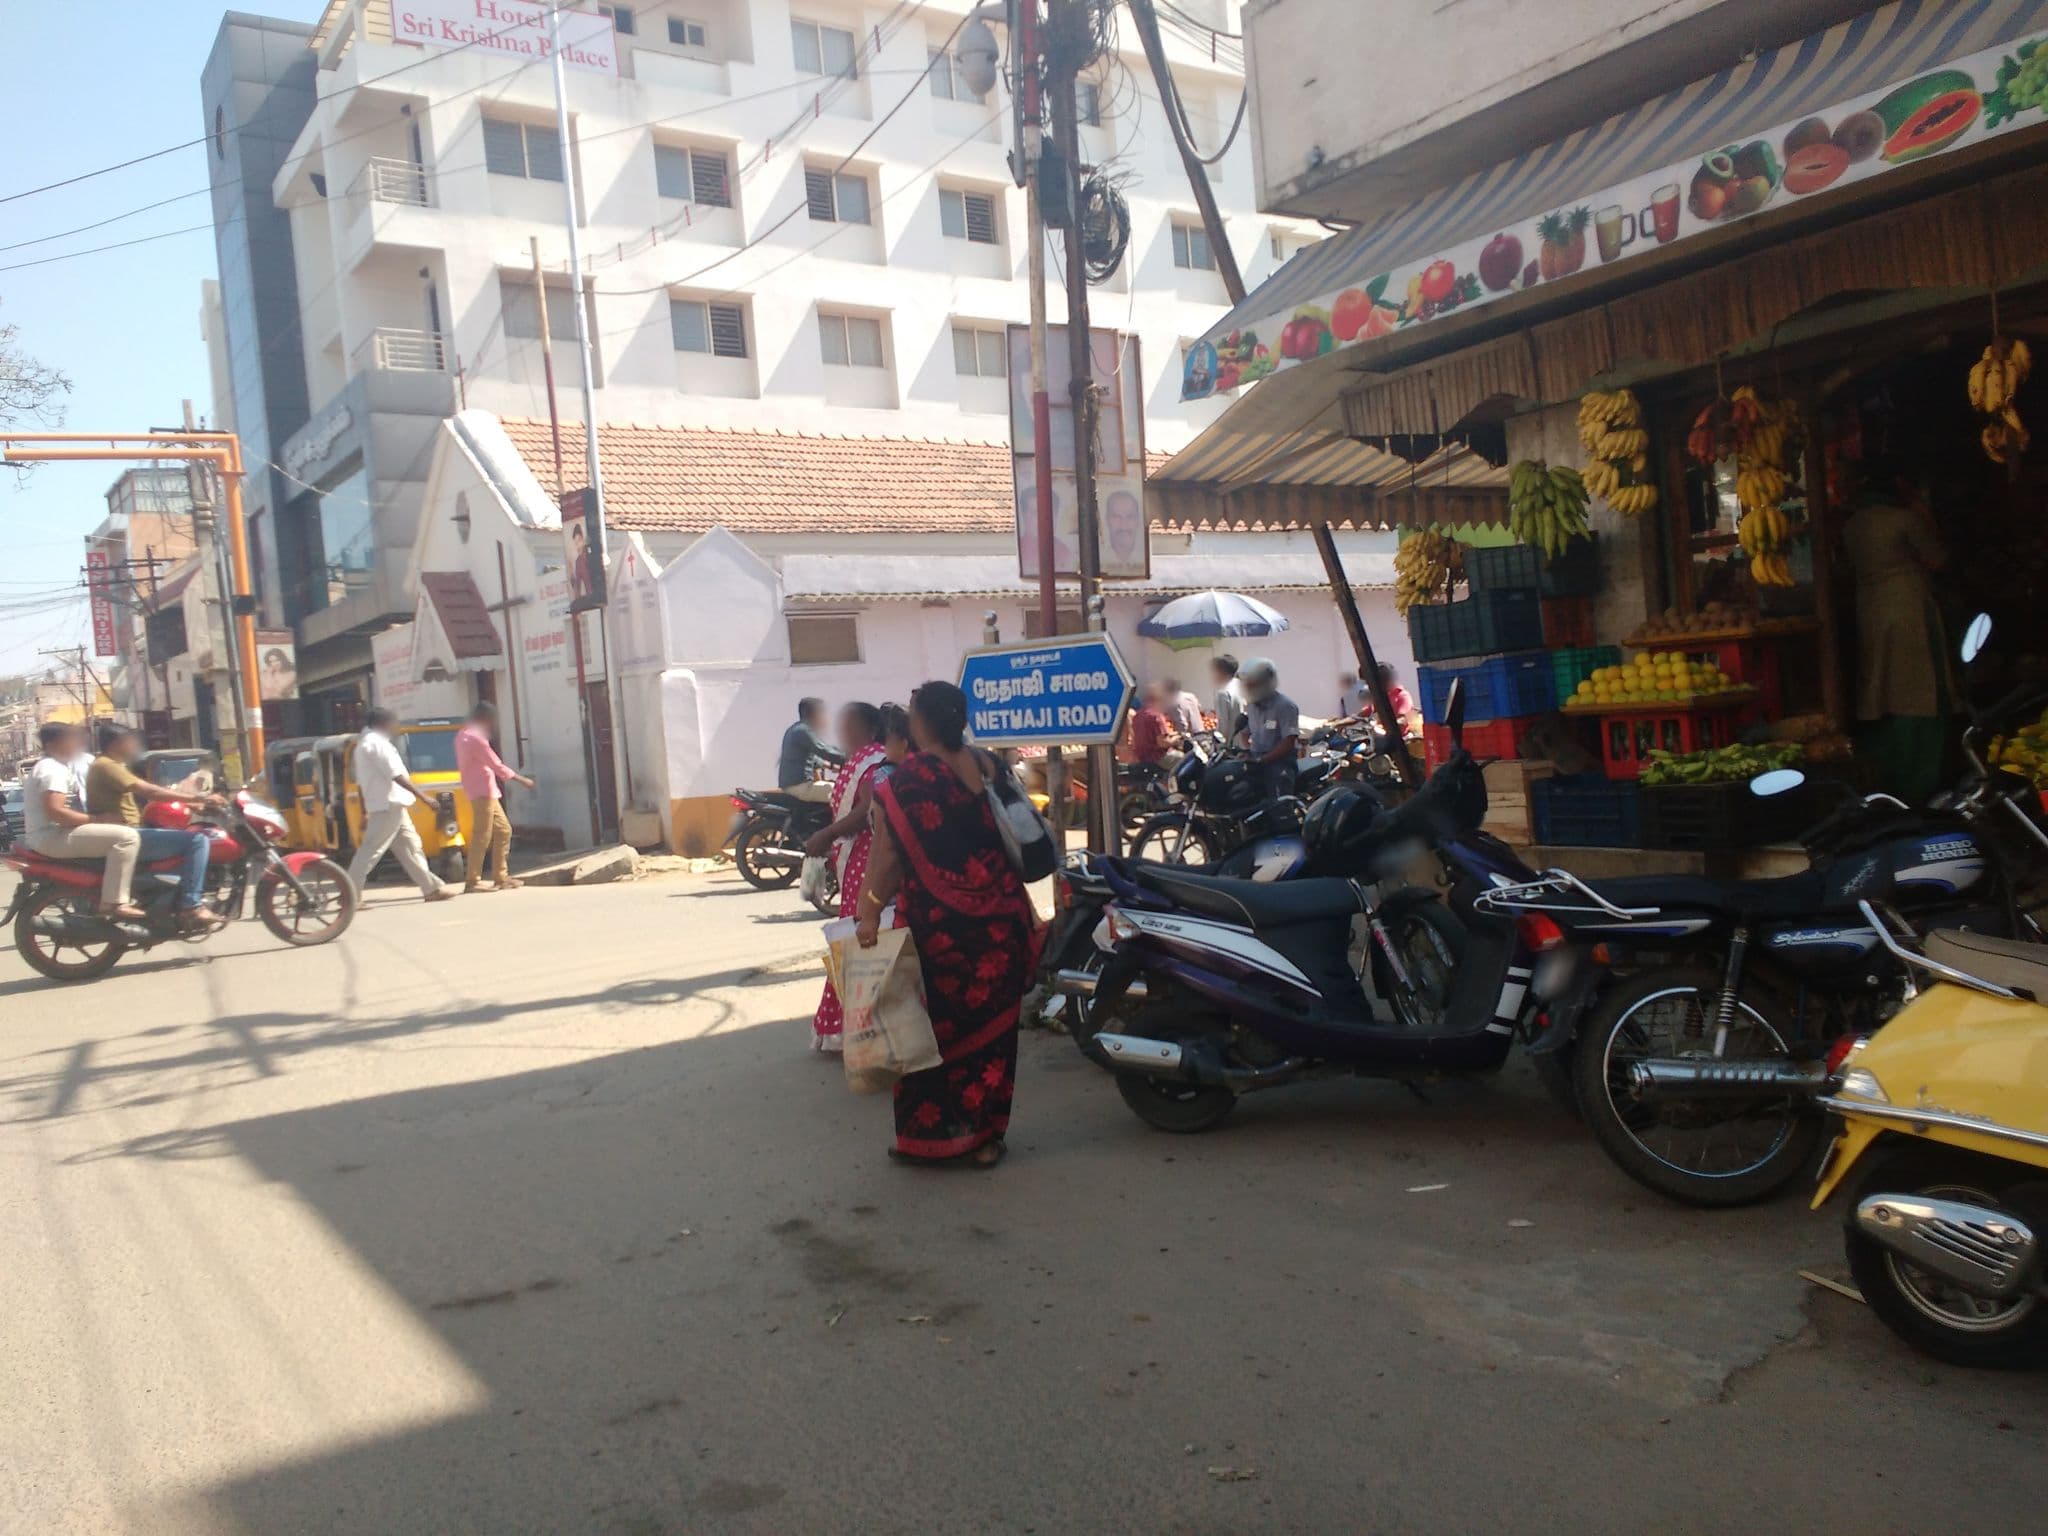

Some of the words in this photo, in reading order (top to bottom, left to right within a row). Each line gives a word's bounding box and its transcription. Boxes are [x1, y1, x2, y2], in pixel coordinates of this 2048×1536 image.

[476, 0, 545, 29] Hotel
[402, 12, 434, 38] Sri
[440, 17, 532, 54] Krishna
[973, 669, 1044, 704] நேதாஜி
[1050, 671, 1109, 693] சாலை
[1058, 704, 1112, 727] ROAD
[1921, 848, 1979, 861] HONDA
[1924, 840, 1971, 852] HERO
